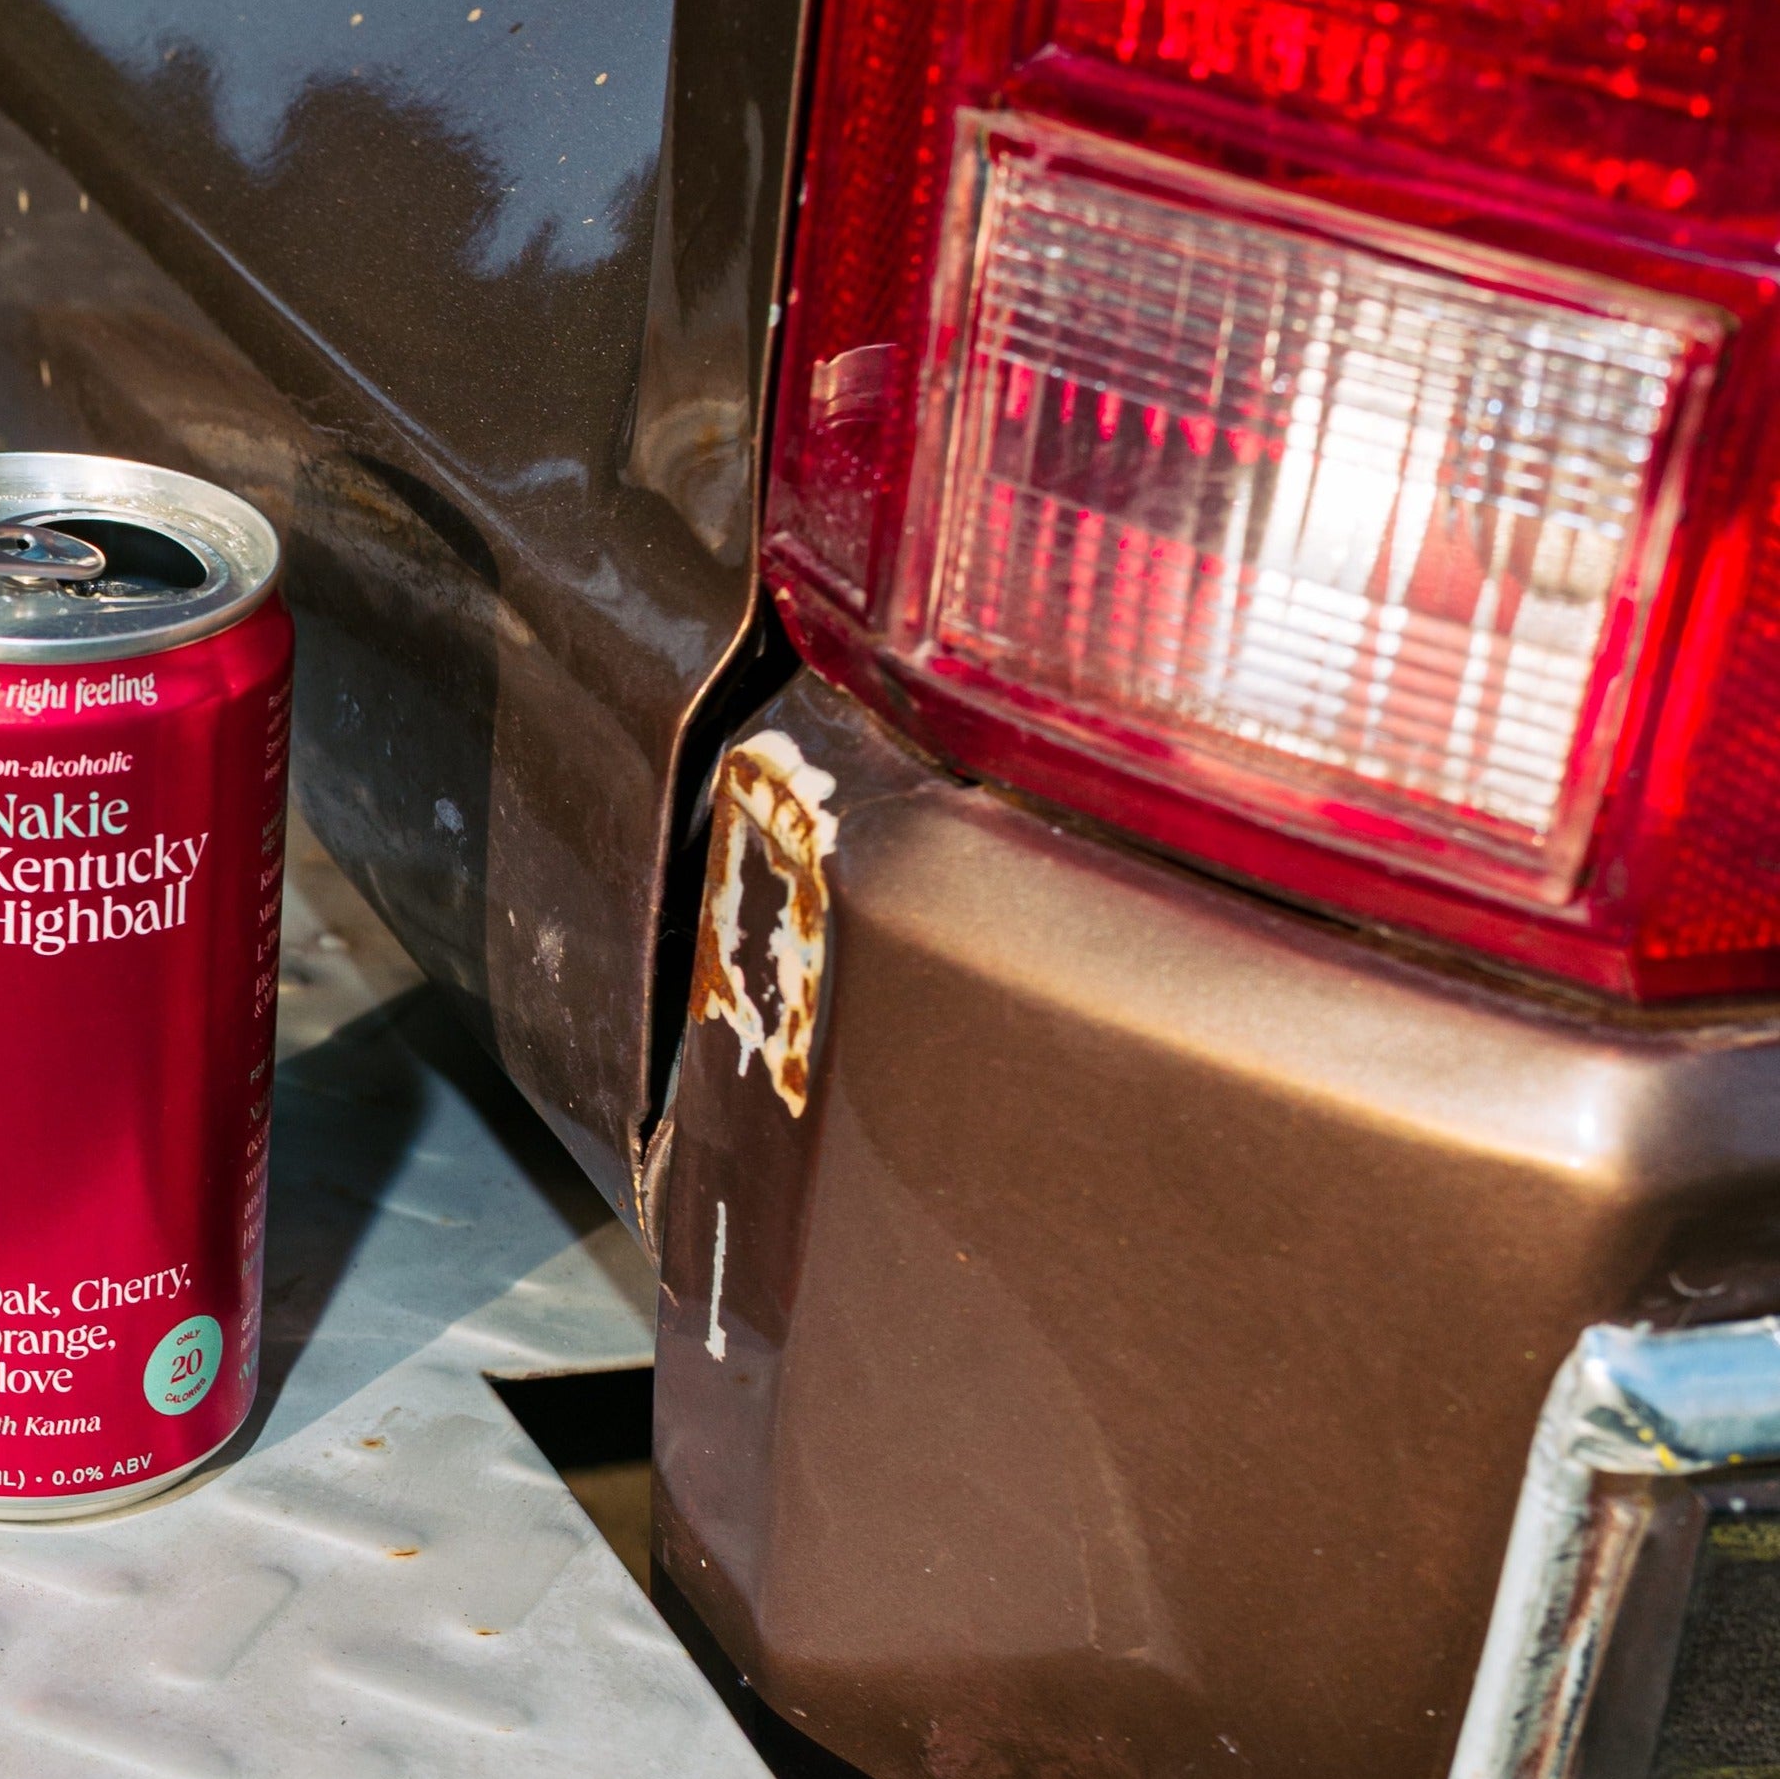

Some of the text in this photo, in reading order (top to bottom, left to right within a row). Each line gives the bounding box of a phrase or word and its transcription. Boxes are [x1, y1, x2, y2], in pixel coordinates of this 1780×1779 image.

[6, 679, 68, 716] right
[75, 671, 158, 714] feeling
[72, 1263, 191, 1312] Cherry,
[176, 1329, 201, 1346] ONLY
[171, 1348, 203, 1384] 20
[165, 1377, 206, 1404] CALORIES
[24, 1415, 101, 1437] Kanna
[52, 1465, 104, 1486] 0.0%
[111, 1453, 153, 1478] ABV
